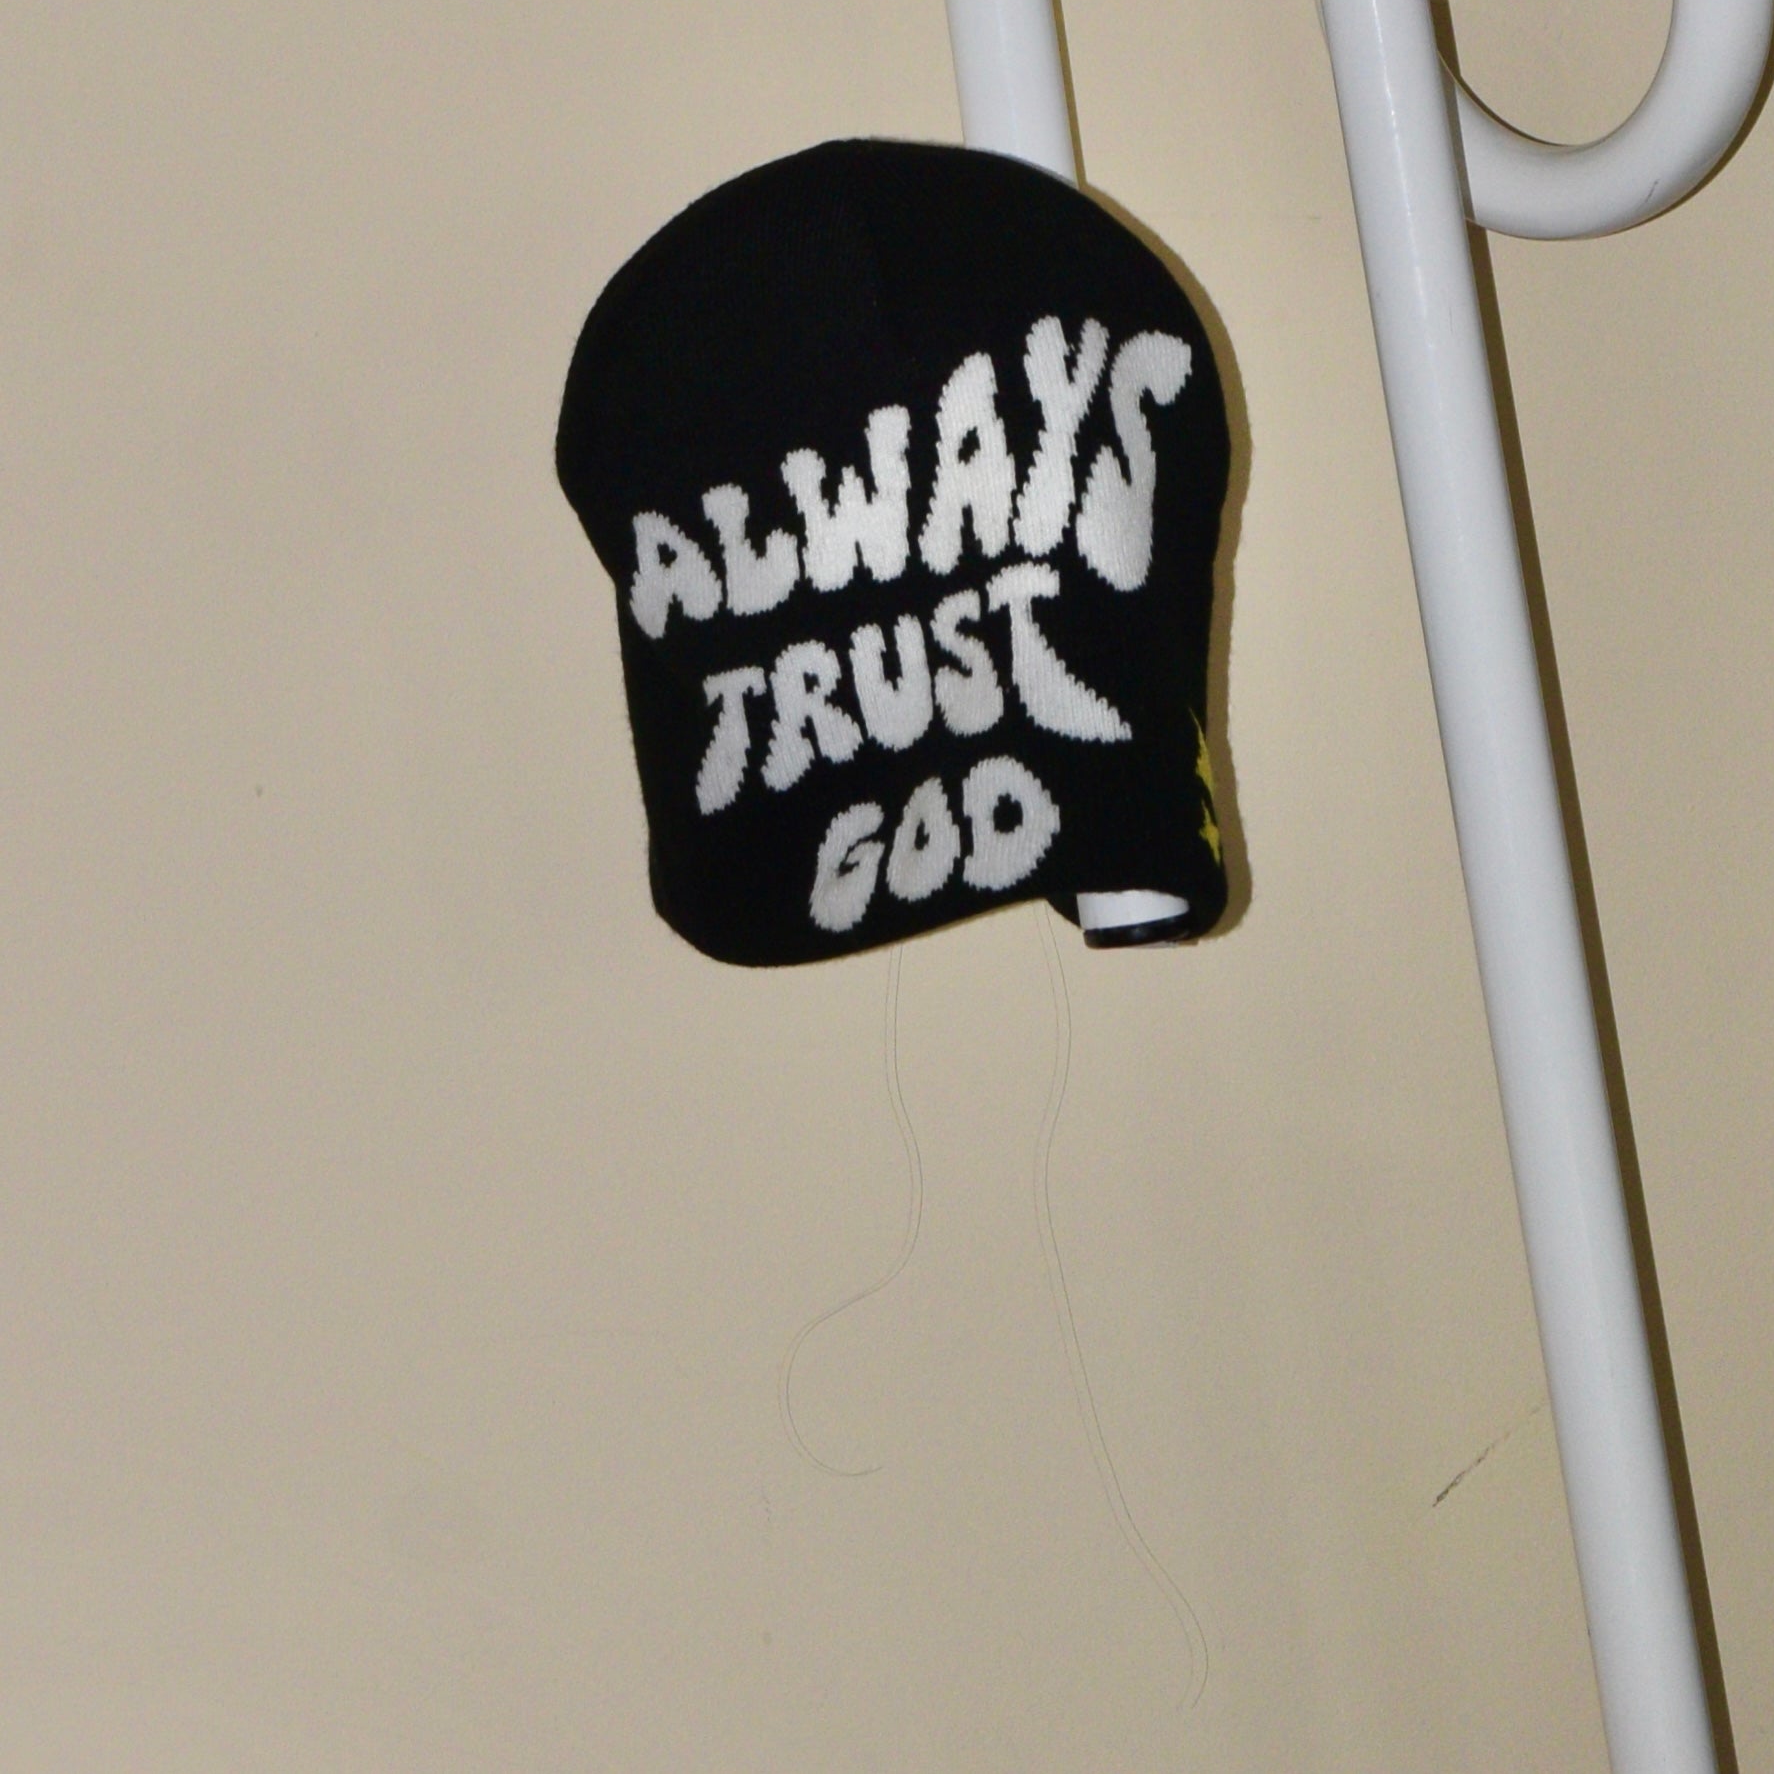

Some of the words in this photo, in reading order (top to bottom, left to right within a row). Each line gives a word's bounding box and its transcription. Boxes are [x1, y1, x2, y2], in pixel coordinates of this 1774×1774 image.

[629, 314, 1193, 641] ALWAYS
[695, 561, 1133, 815] TRUST
[809, 753, 1061, 933] GOD
